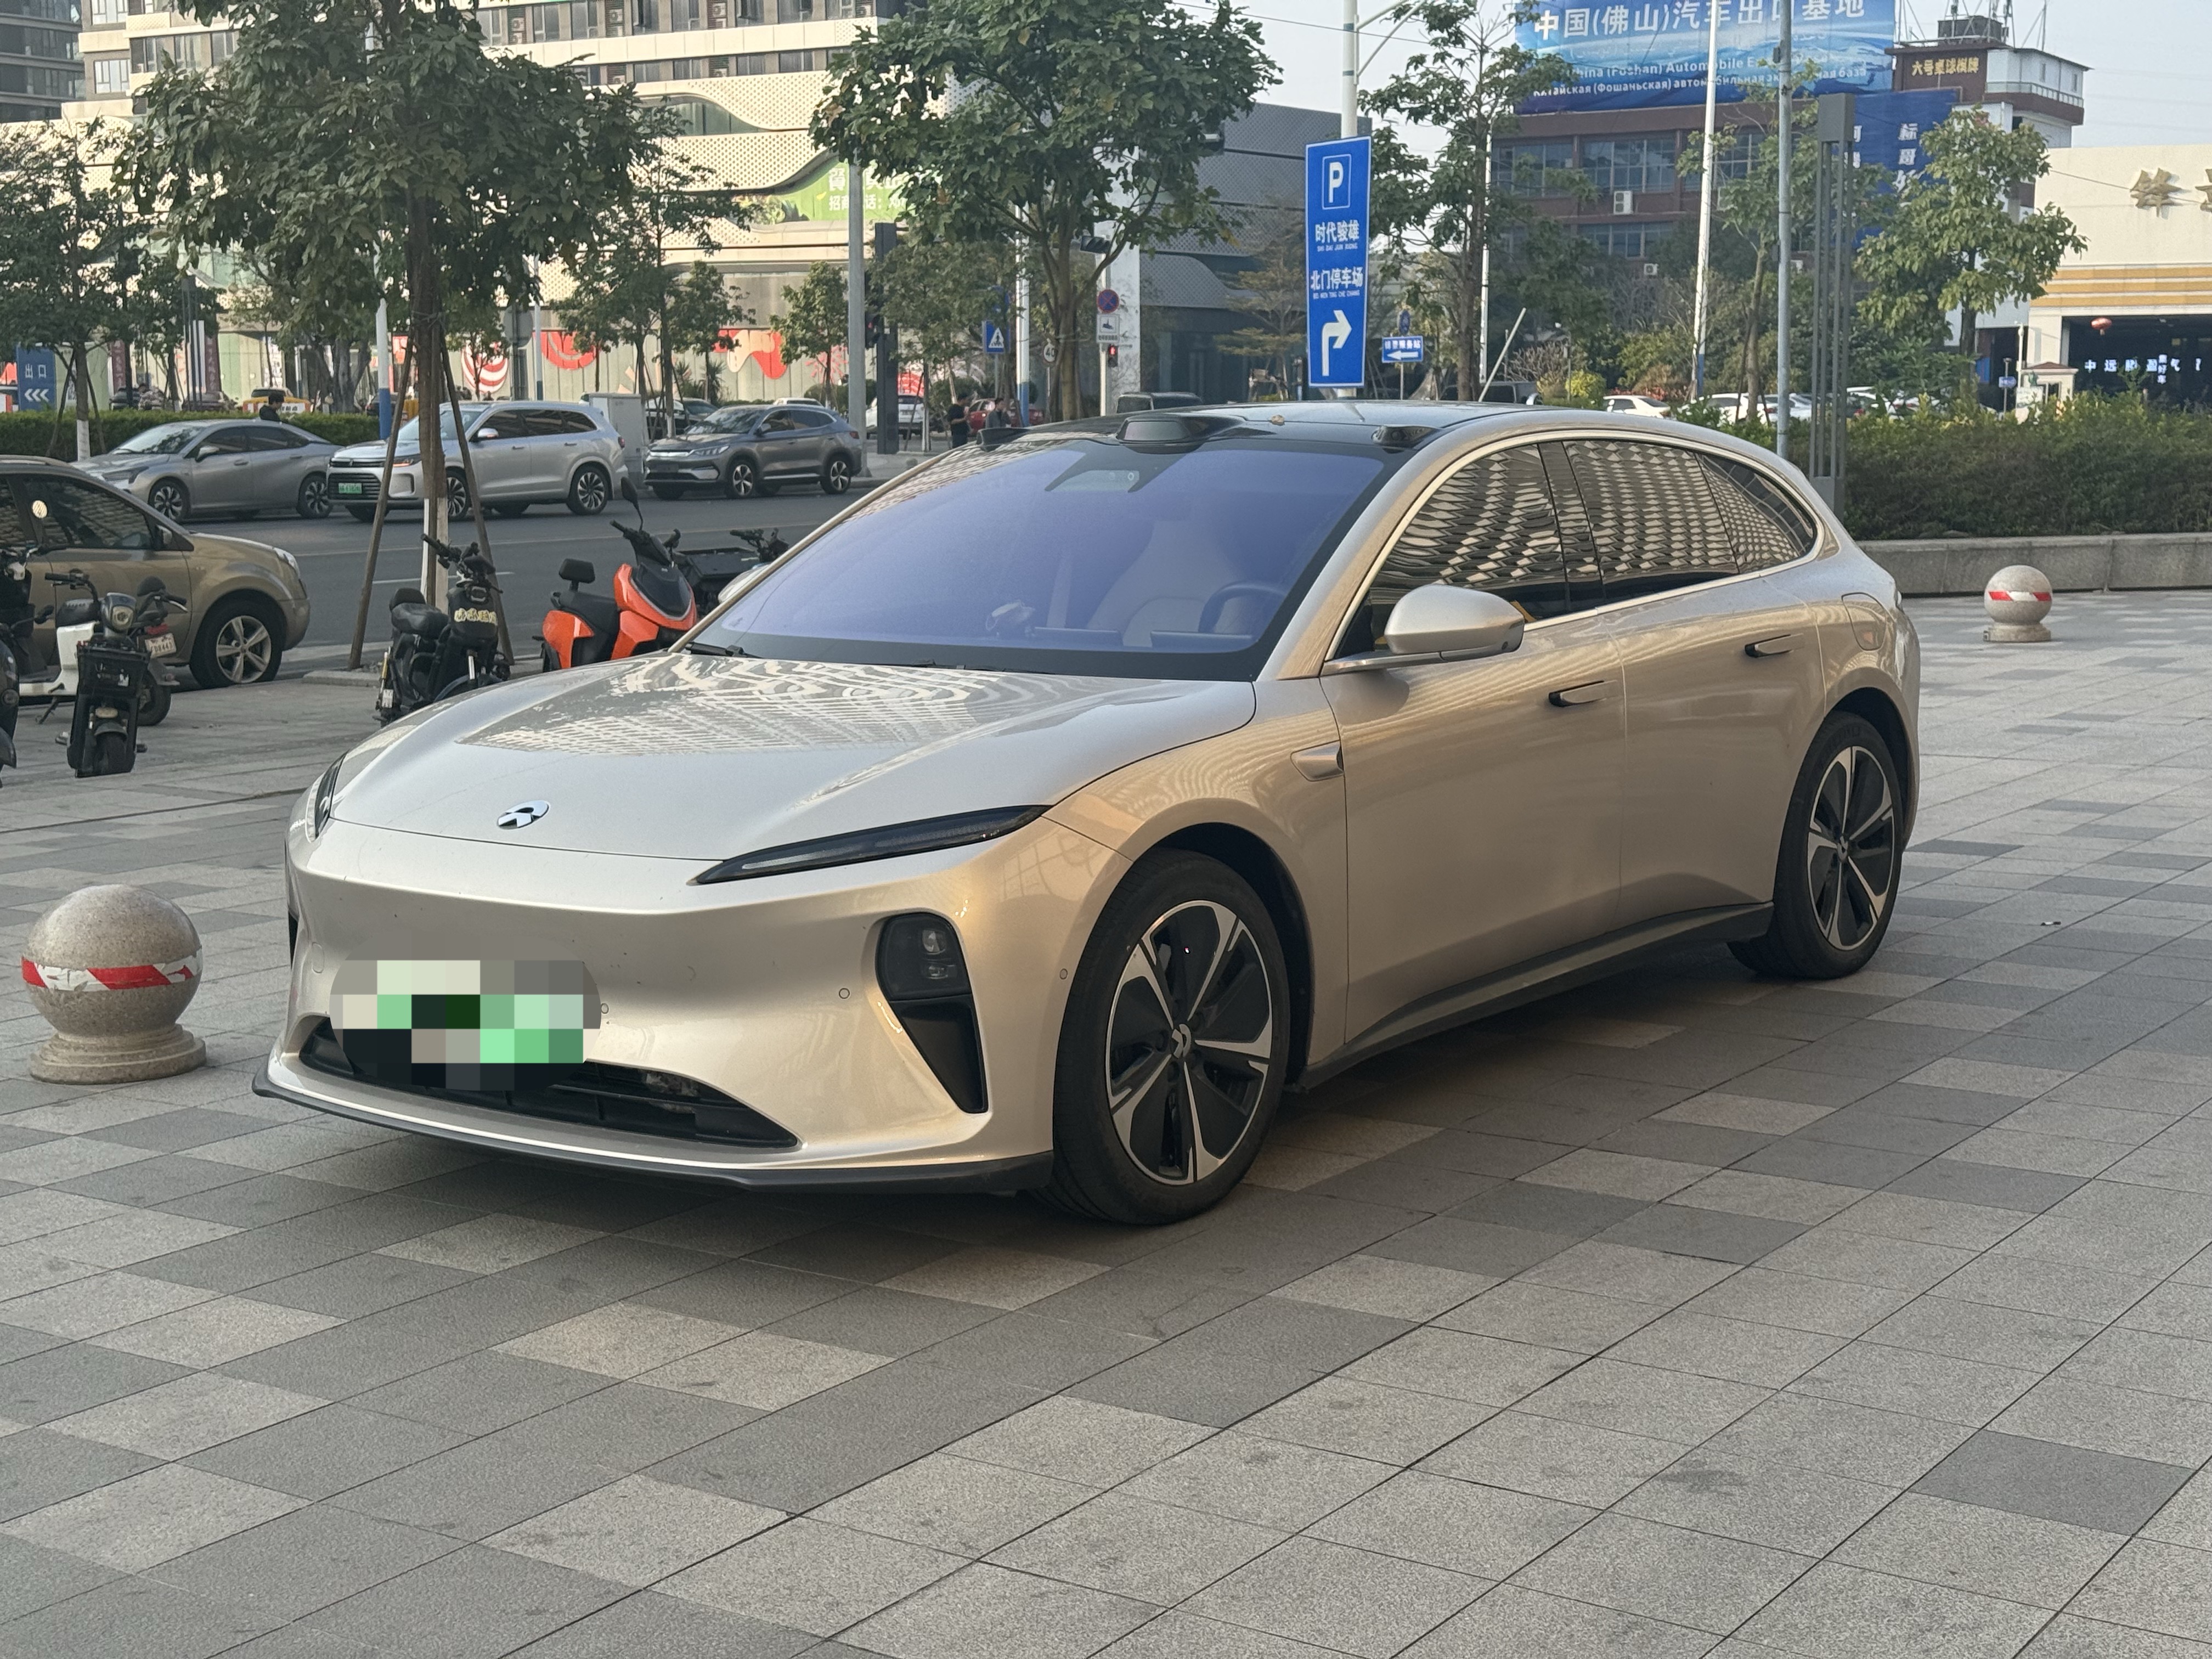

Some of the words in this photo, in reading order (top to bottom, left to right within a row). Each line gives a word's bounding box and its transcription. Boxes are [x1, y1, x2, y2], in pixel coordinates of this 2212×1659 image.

[1567, 67, 1603, 78] hina
[1607, 64, 1662, 77] (Foshan)
[1666, 58, 1743, 73] Autombile
[1594, 78, 1672, 95] (Фошаньская)
[1674, 74, 1764, 88] автомбильная
[1329, 162, 1344, 203] P
[1315, 219, 1359, 243] 时代骏雄
[1311, 267, 1363, 290] 北门停车场
[25, 364, 46, 379] 出口
